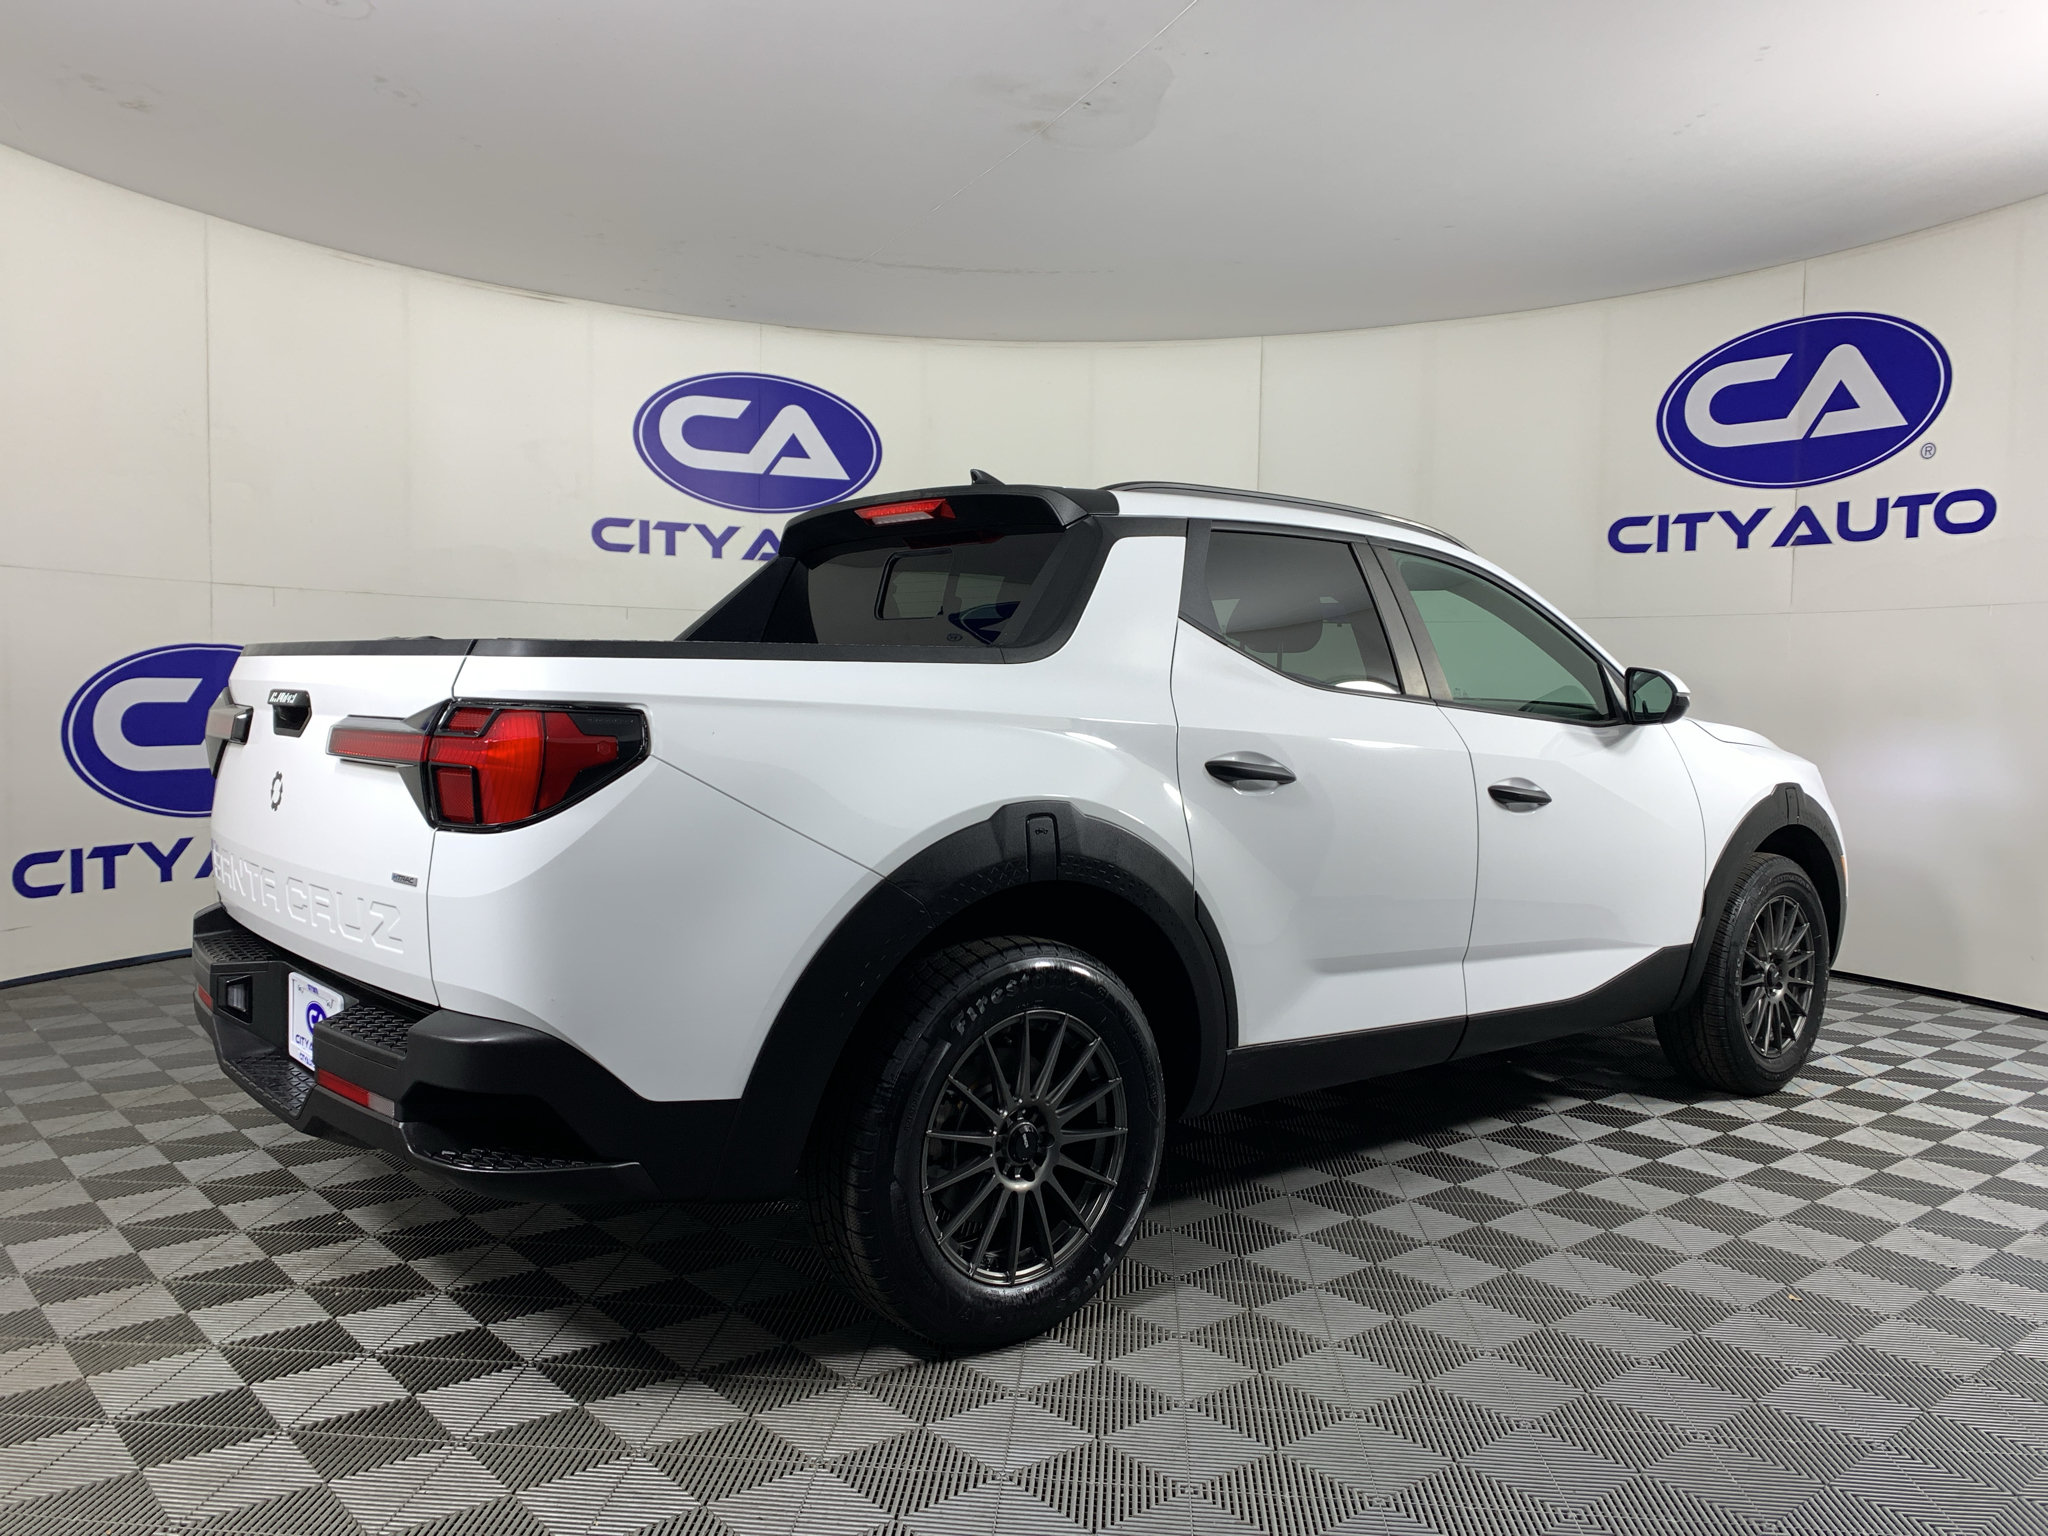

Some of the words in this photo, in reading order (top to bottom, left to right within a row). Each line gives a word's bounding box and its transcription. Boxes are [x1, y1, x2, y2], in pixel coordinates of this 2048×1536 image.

[1684, 343, 1909, 448] CA
[658, 394, 851, 481] CA
[590, 516, 742, 560] CITY
[1607, 507, 1774, 554] CITY
[1770, 488, 1998, 548] AUTO
[92, 676, 213, 772] C
[11, 836, 194, 899] CITY
[285, 875, 405, 955] CRUZ
